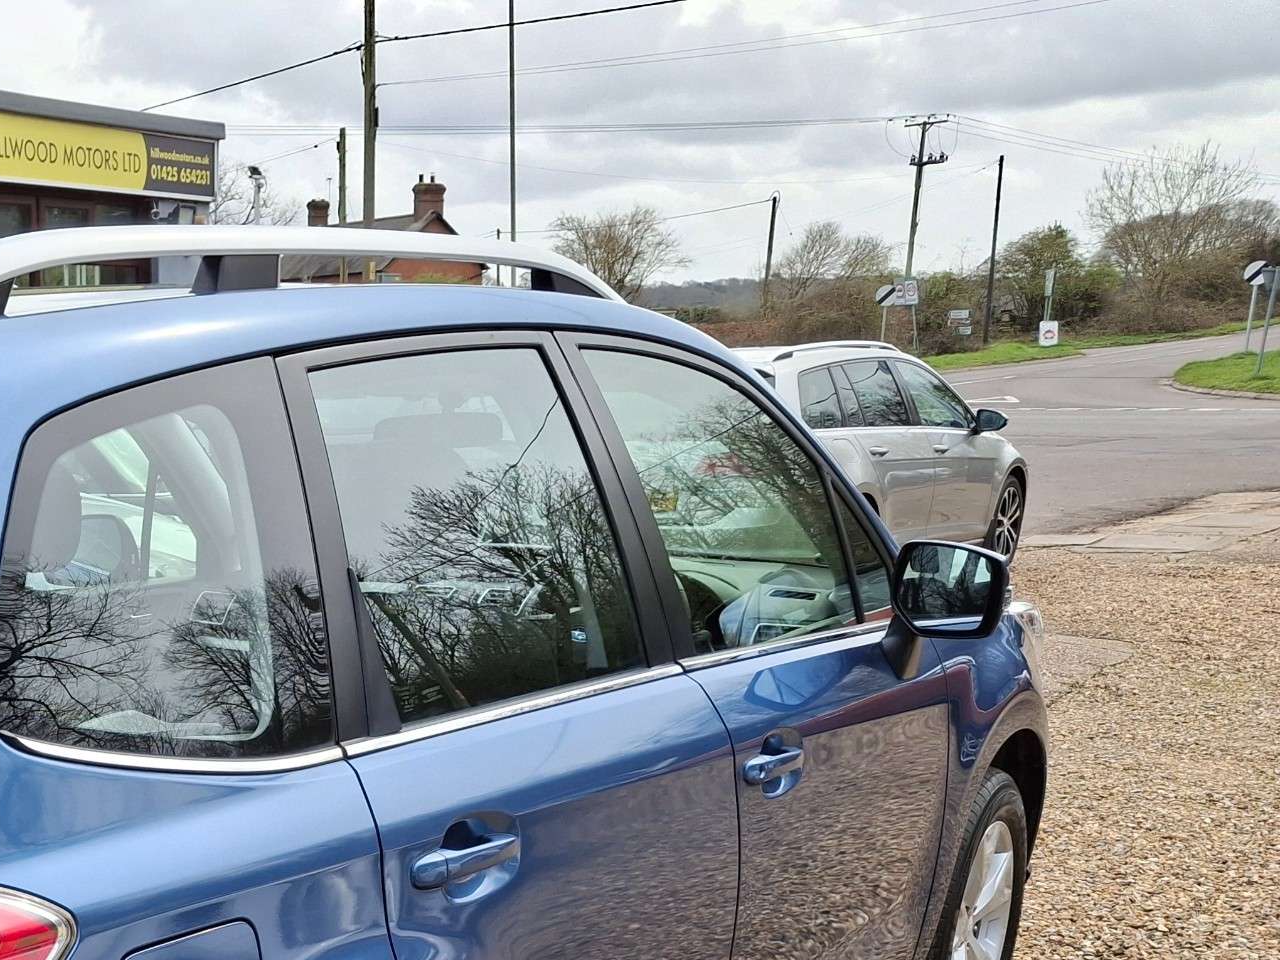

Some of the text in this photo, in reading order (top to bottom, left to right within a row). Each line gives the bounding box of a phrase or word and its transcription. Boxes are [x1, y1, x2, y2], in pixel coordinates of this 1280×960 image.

[63, 144, 119, 171] MOTORS
[123, 151, 141, 174] LTD
[150, 147, 210, 165] hillwoodmotors.co.uk
[151, 164, 210, 185] 01425 654231
